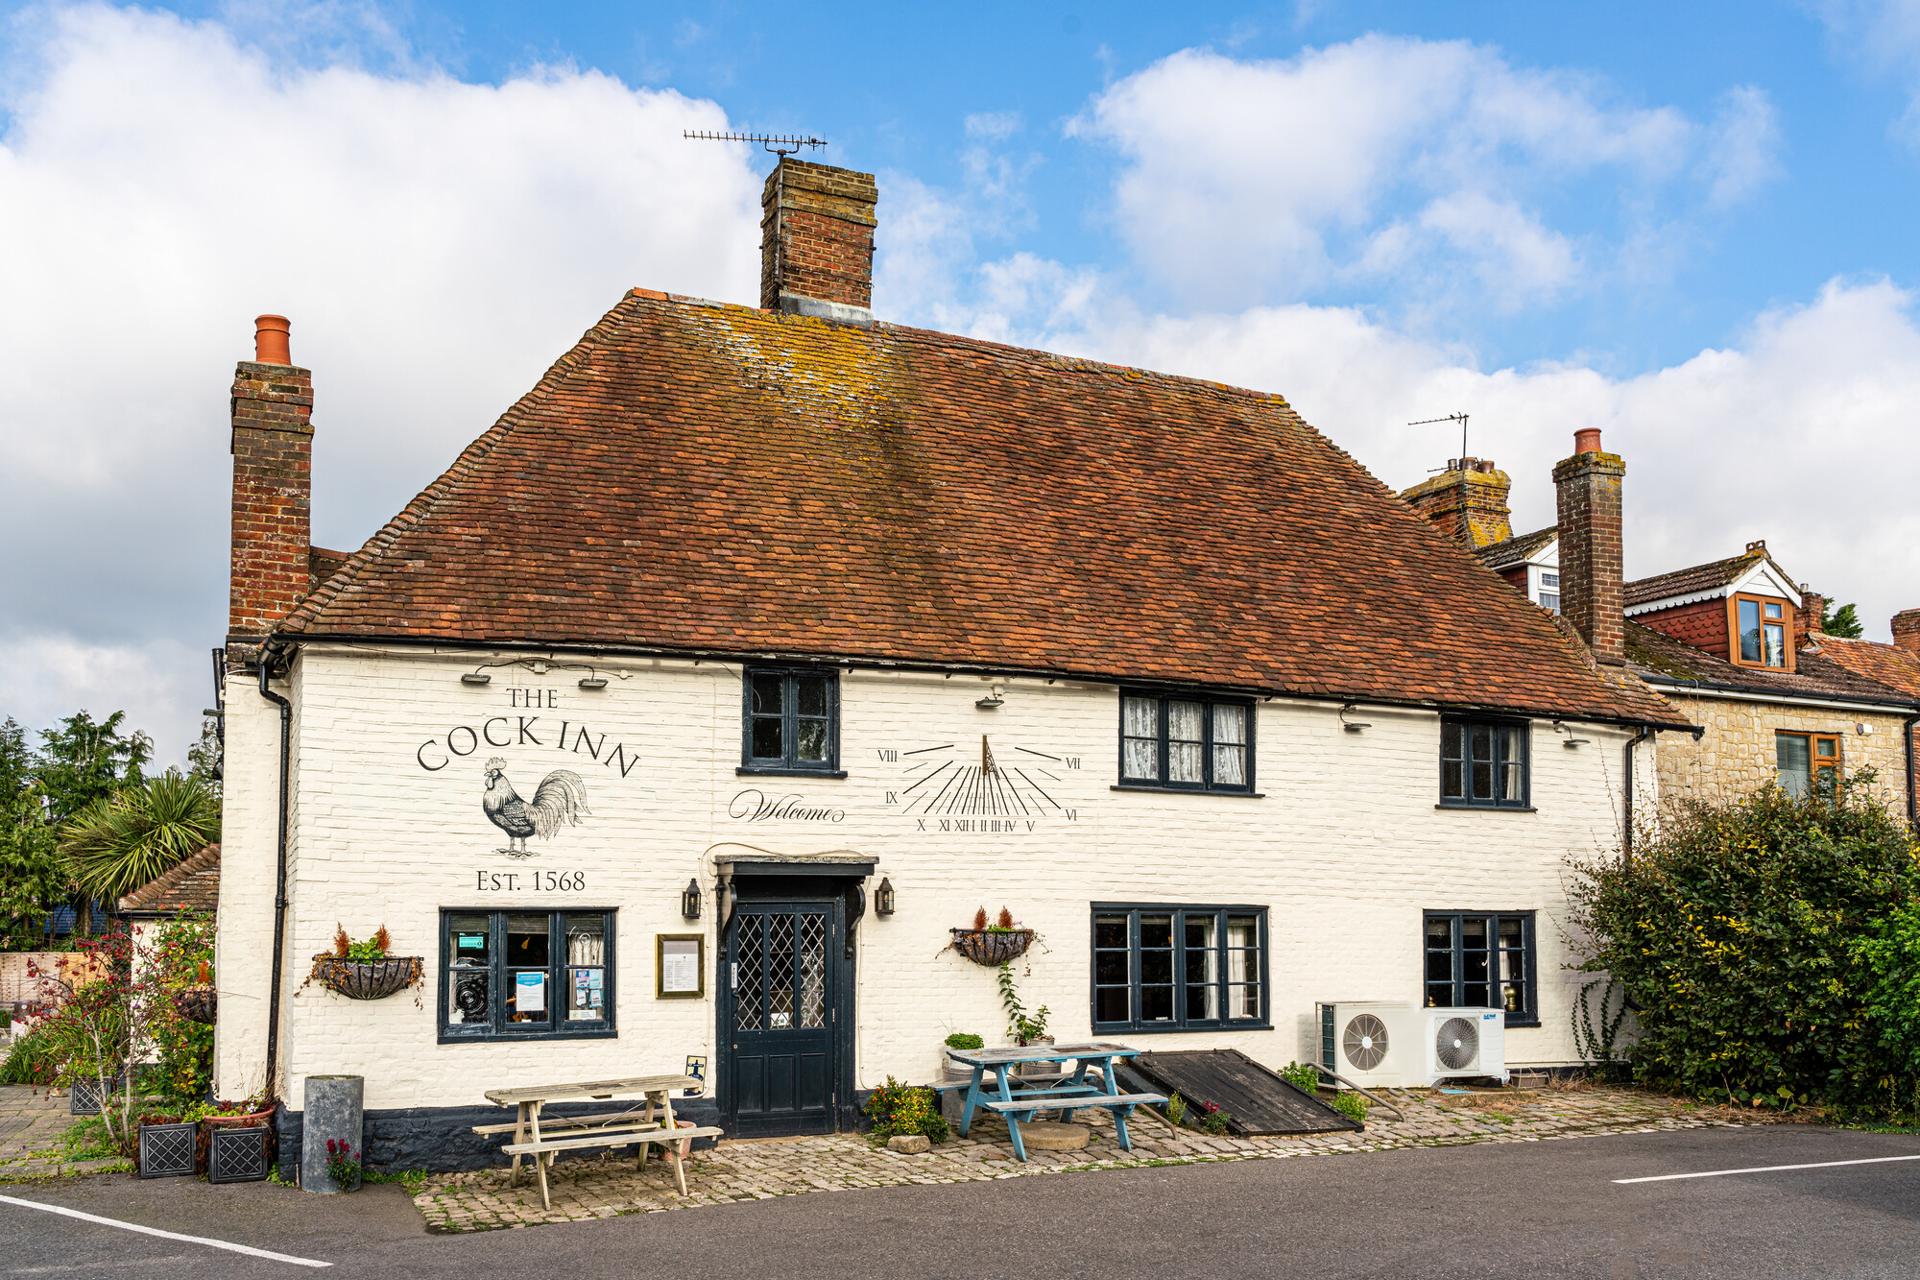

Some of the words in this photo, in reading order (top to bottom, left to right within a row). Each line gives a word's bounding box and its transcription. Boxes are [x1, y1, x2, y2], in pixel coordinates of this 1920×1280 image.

[506, 687, 558, 709] THE
[416, 716, 544, 772] COCK
[556, 720, 641, 779] INN
[877, 749, 898, 762] VIII
[1065, 757, 1081, 770] VII
[885, 791, 898, 804] IX
[728, 788, 846, 823] Welcome
[1065, 809, 1078, 821] VI
[916, 818, 926, 832] X
[938, 819, 951, 832] XI
[954, 819, 969, 832] XII
[971, 819, 976, 832] I
[980, 820, 987, 832] II
[990, 820, 1001, 833] III
[1004, 820, 1017, 833] IV
[1026, 820, 1036, 832] V
[476, 870, 521, 891] EST.
[532, 870, 586, 892] 1568
